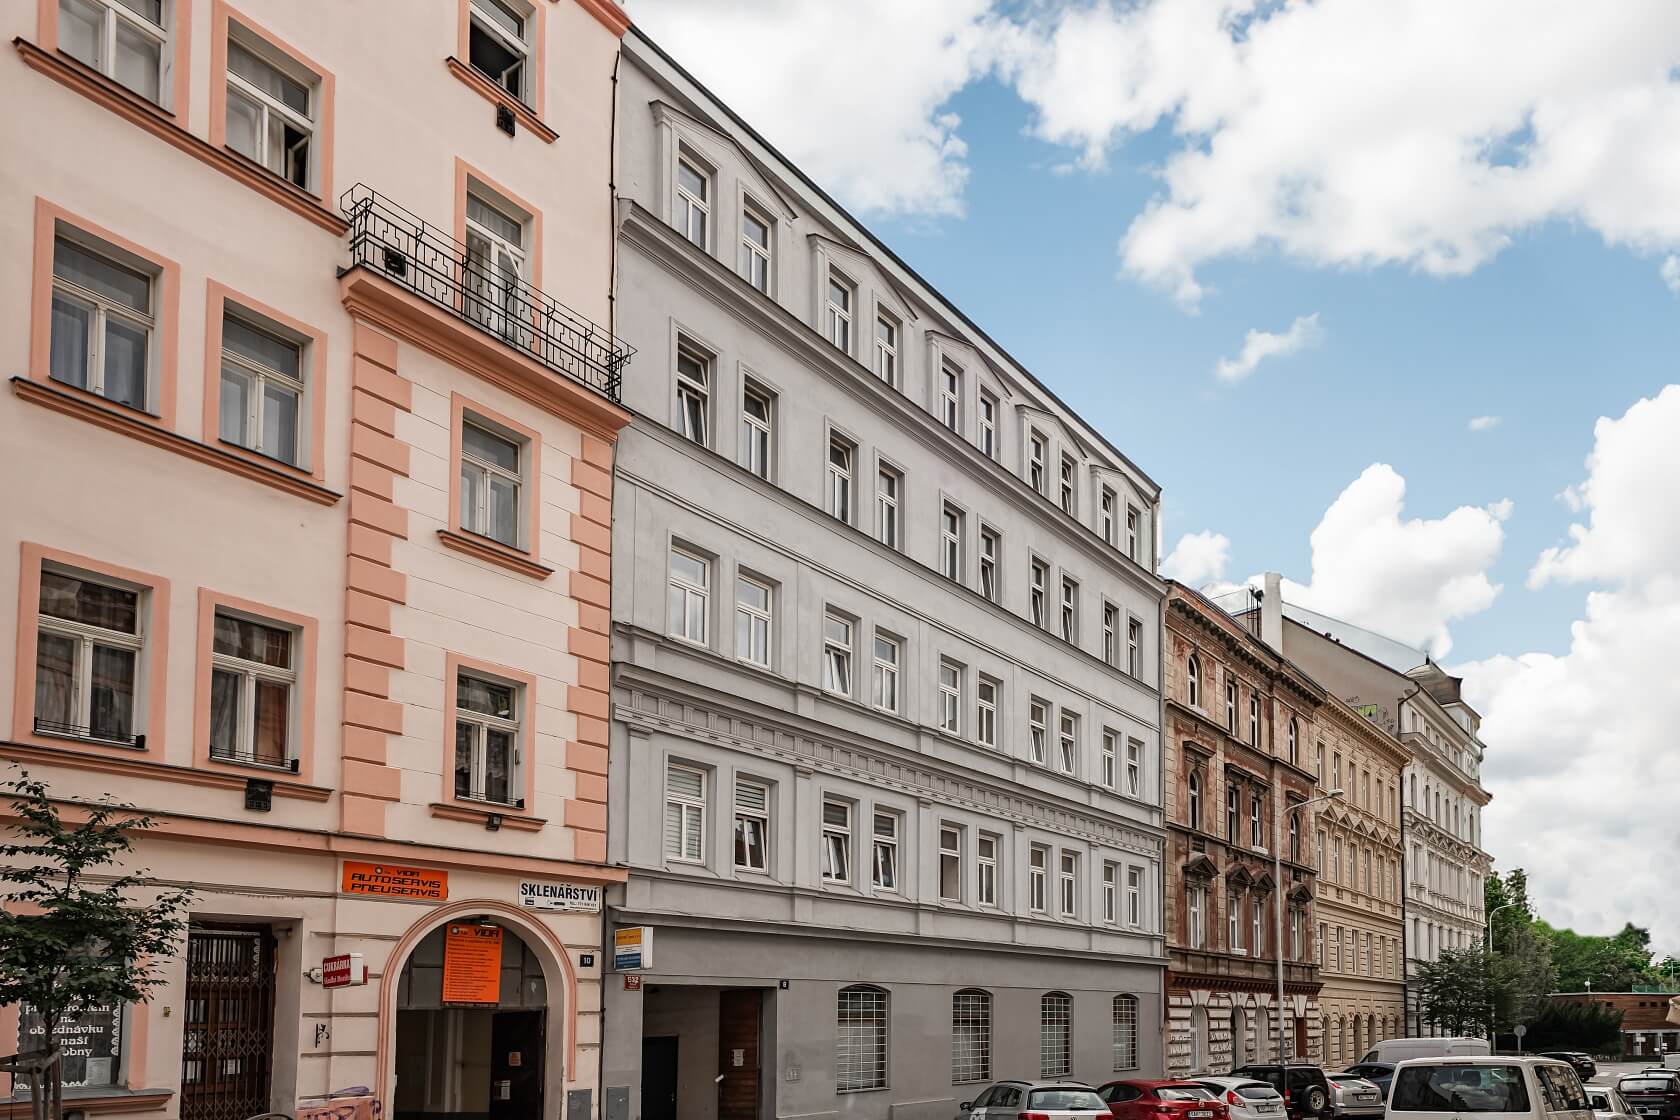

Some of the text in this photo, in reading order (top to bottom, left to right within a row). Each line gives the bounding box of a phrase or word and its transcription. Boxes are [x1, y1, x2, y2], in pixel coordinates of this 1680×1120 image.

[351, 873, 441, 889] AUTOSERVIS
[351, 883, 441, 898] PNEUSERVIS
[521, 883, 598, 902] SKLENÁŘSTVÍ
[583, 956, 591, 965] 10
[29, 1025, 104, 1035] obednávku
